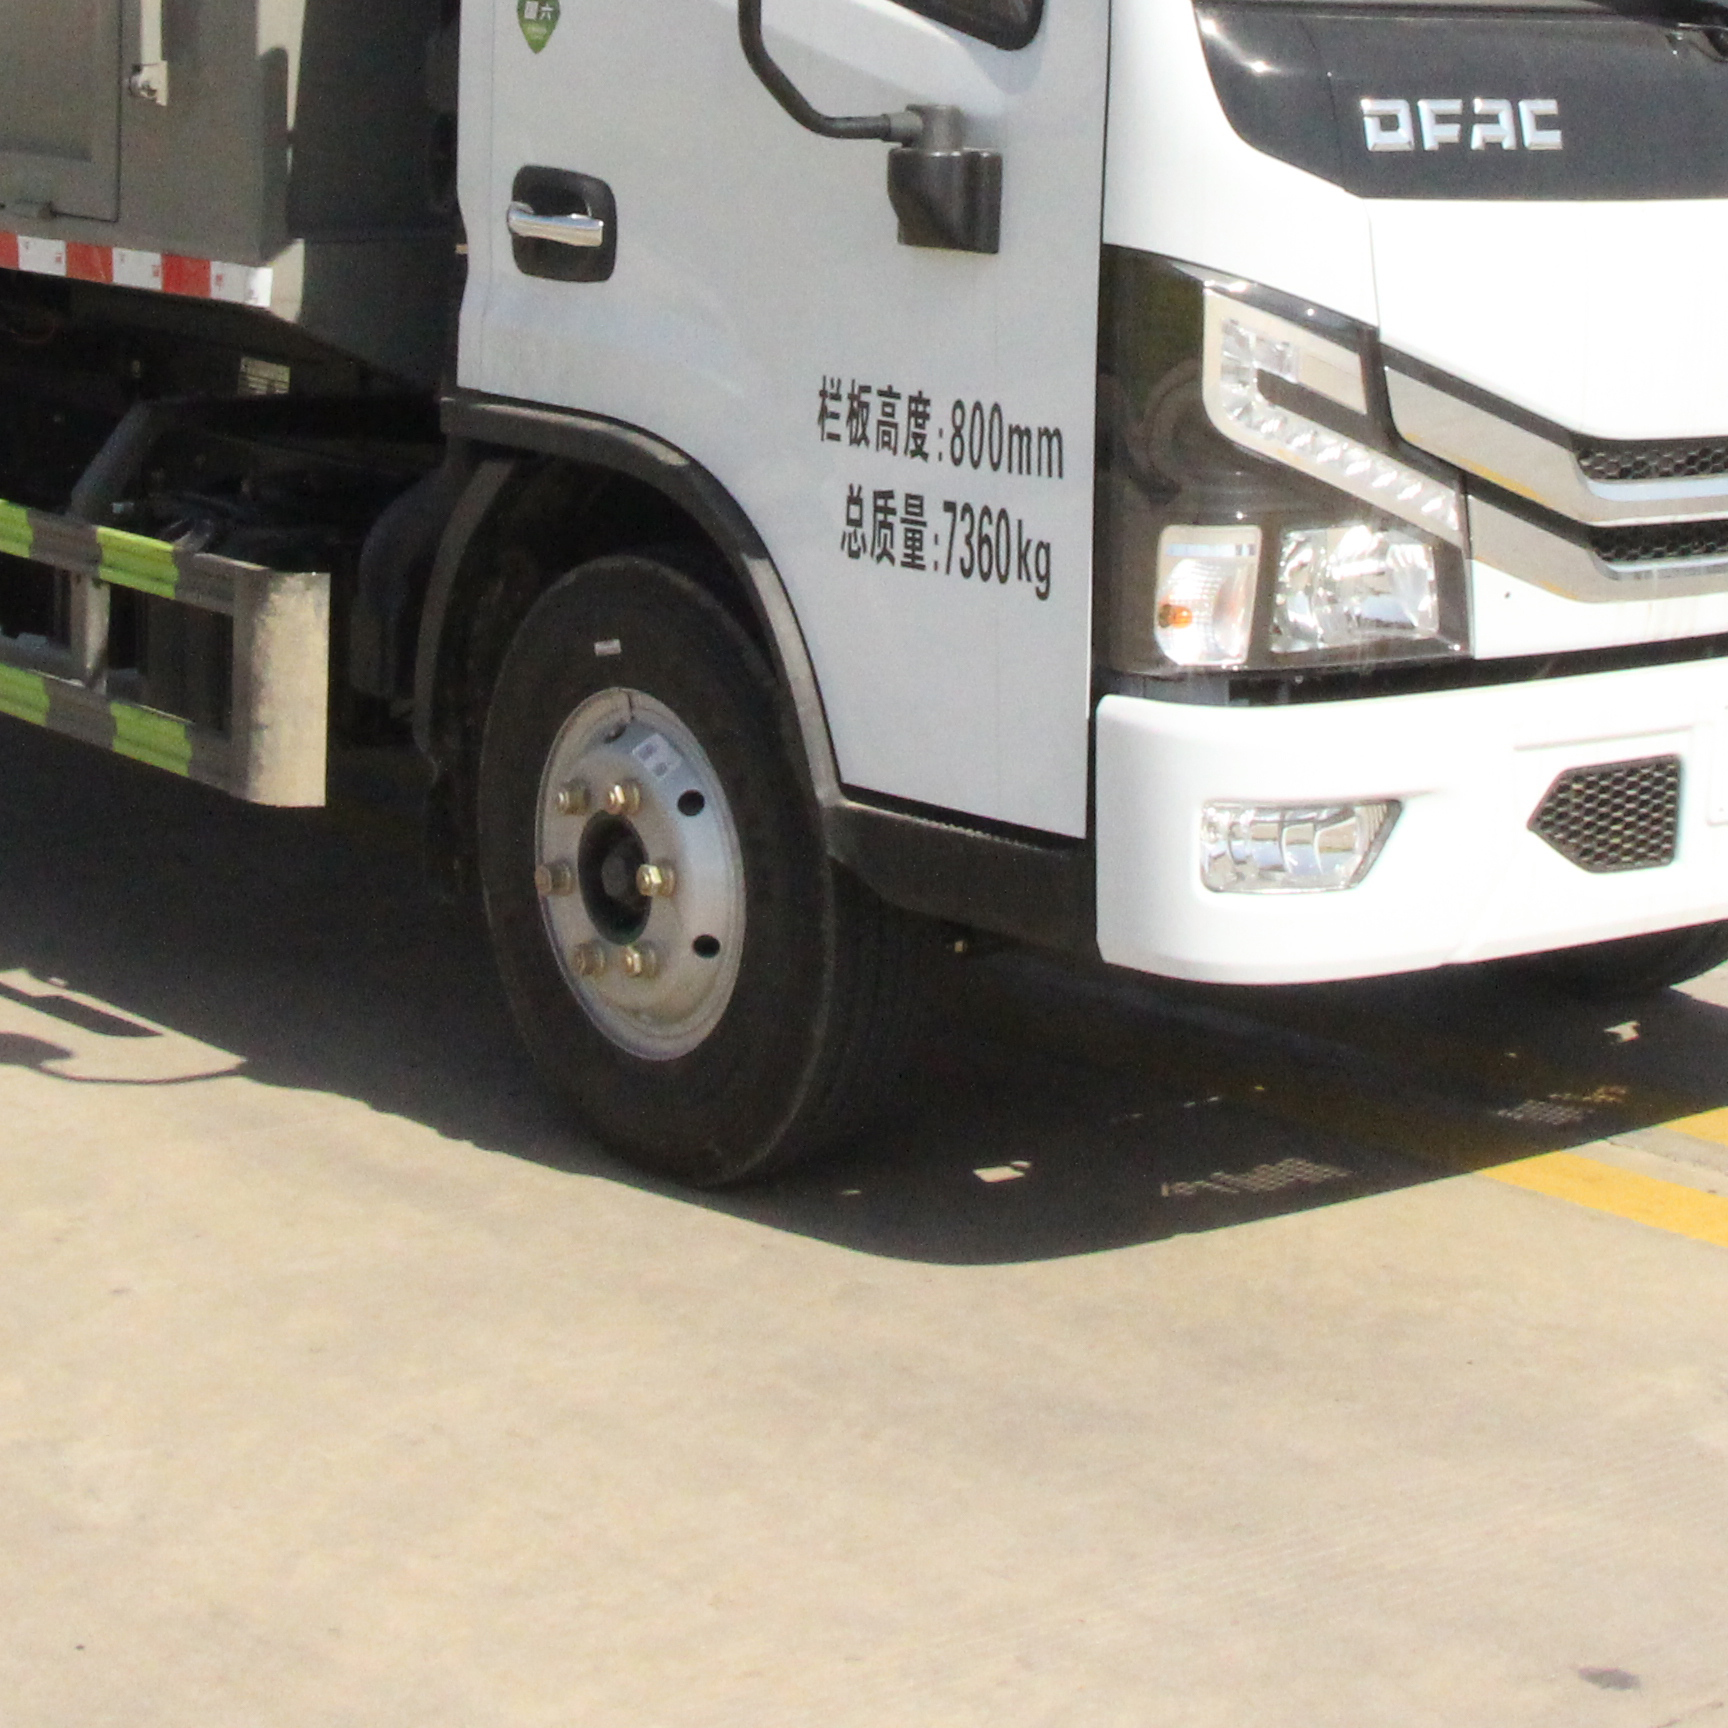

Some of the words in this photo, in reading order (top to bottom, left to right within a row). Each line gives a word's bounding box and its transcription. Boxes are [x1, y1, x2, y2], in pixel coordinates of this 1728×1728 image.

[1360, 98, 1563, 152] DFAC
[840, 483, 1051, 601] 总质量:7360kg
